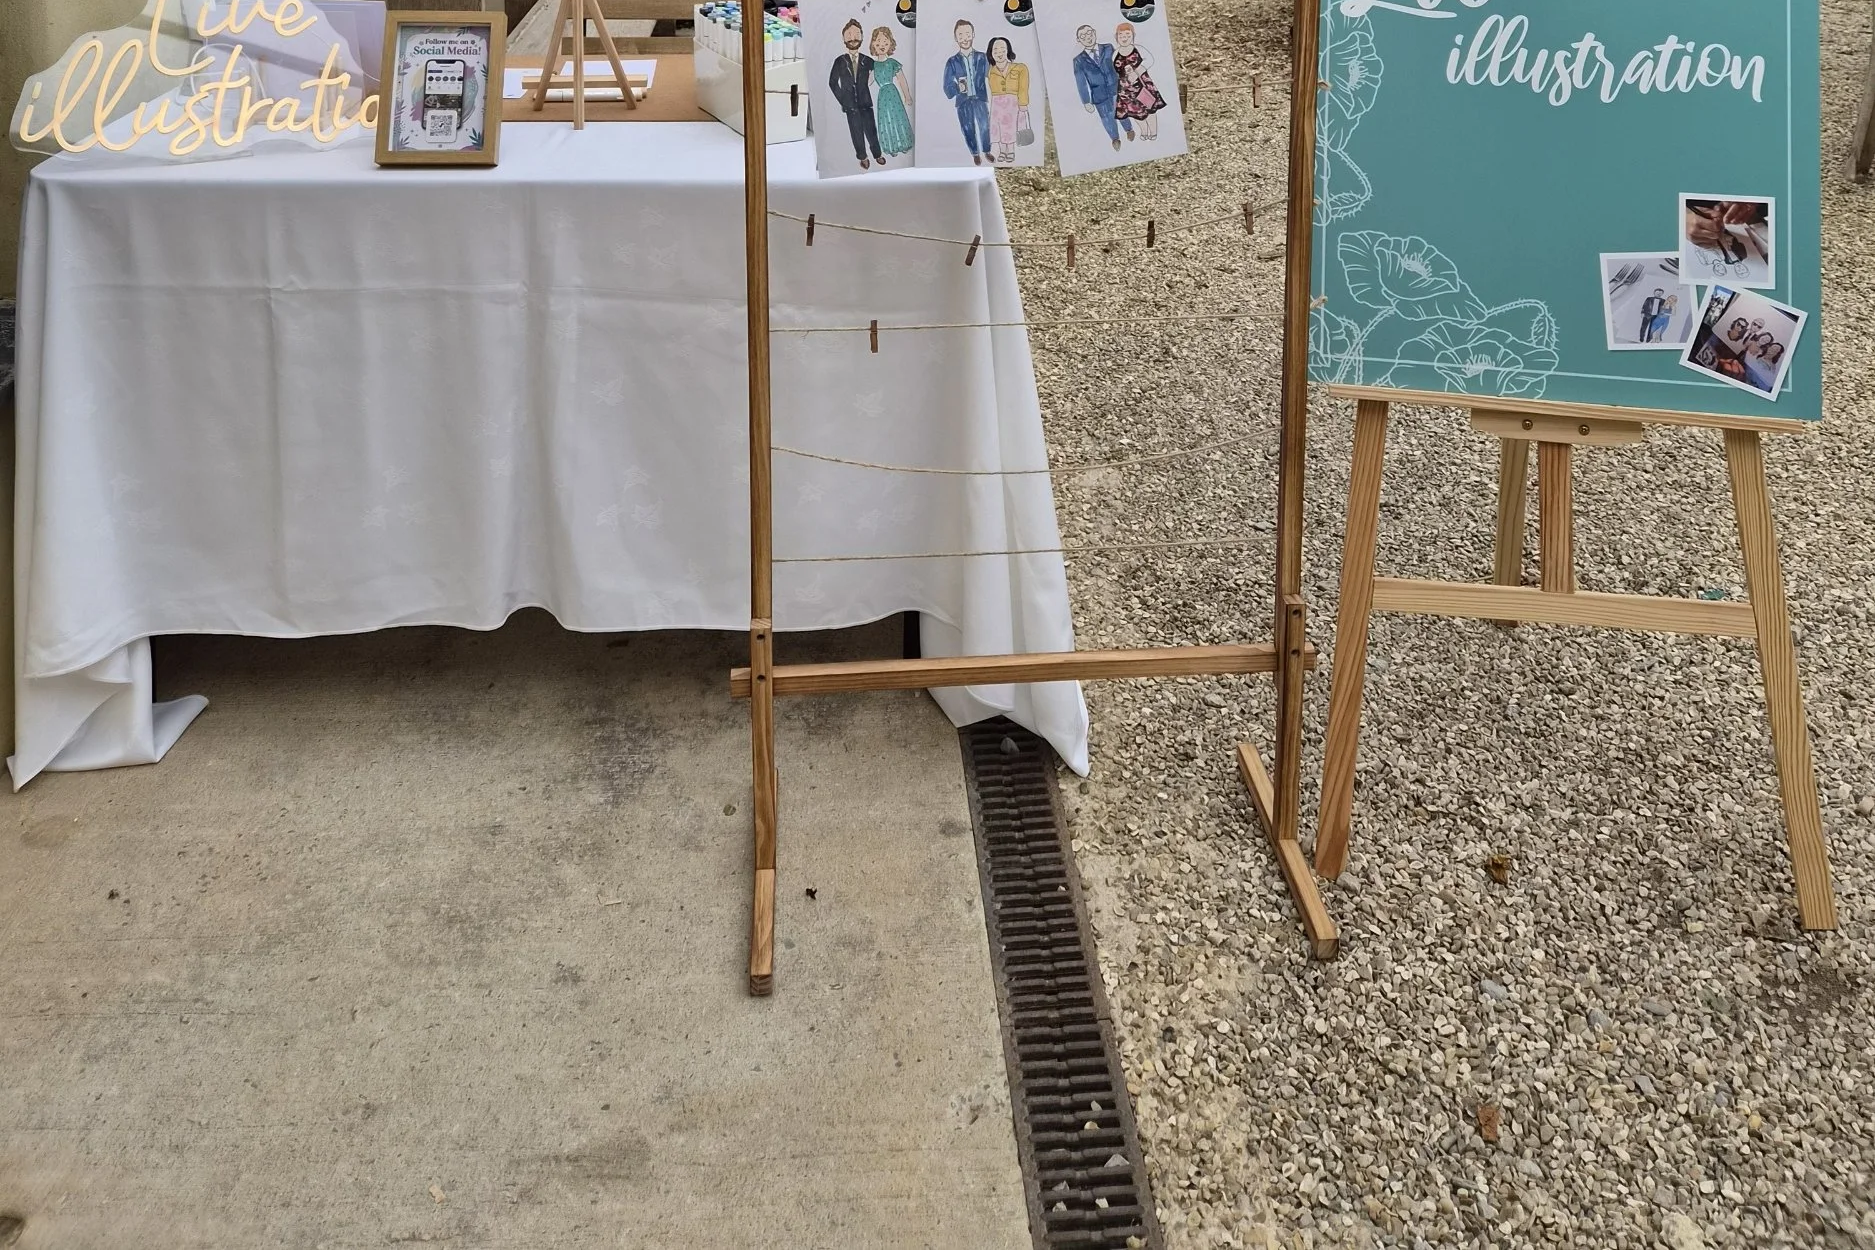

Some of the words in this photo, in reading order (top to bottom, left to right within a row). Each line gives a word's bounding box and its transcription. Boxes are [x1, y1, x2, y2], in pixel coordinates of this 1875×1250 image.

[19, 38, 379, 155] illustratio
[413, 46, 445, 55] Social
[447, 46, 481, 56] Media!
[1446, 14, 1766, 106] illustration
